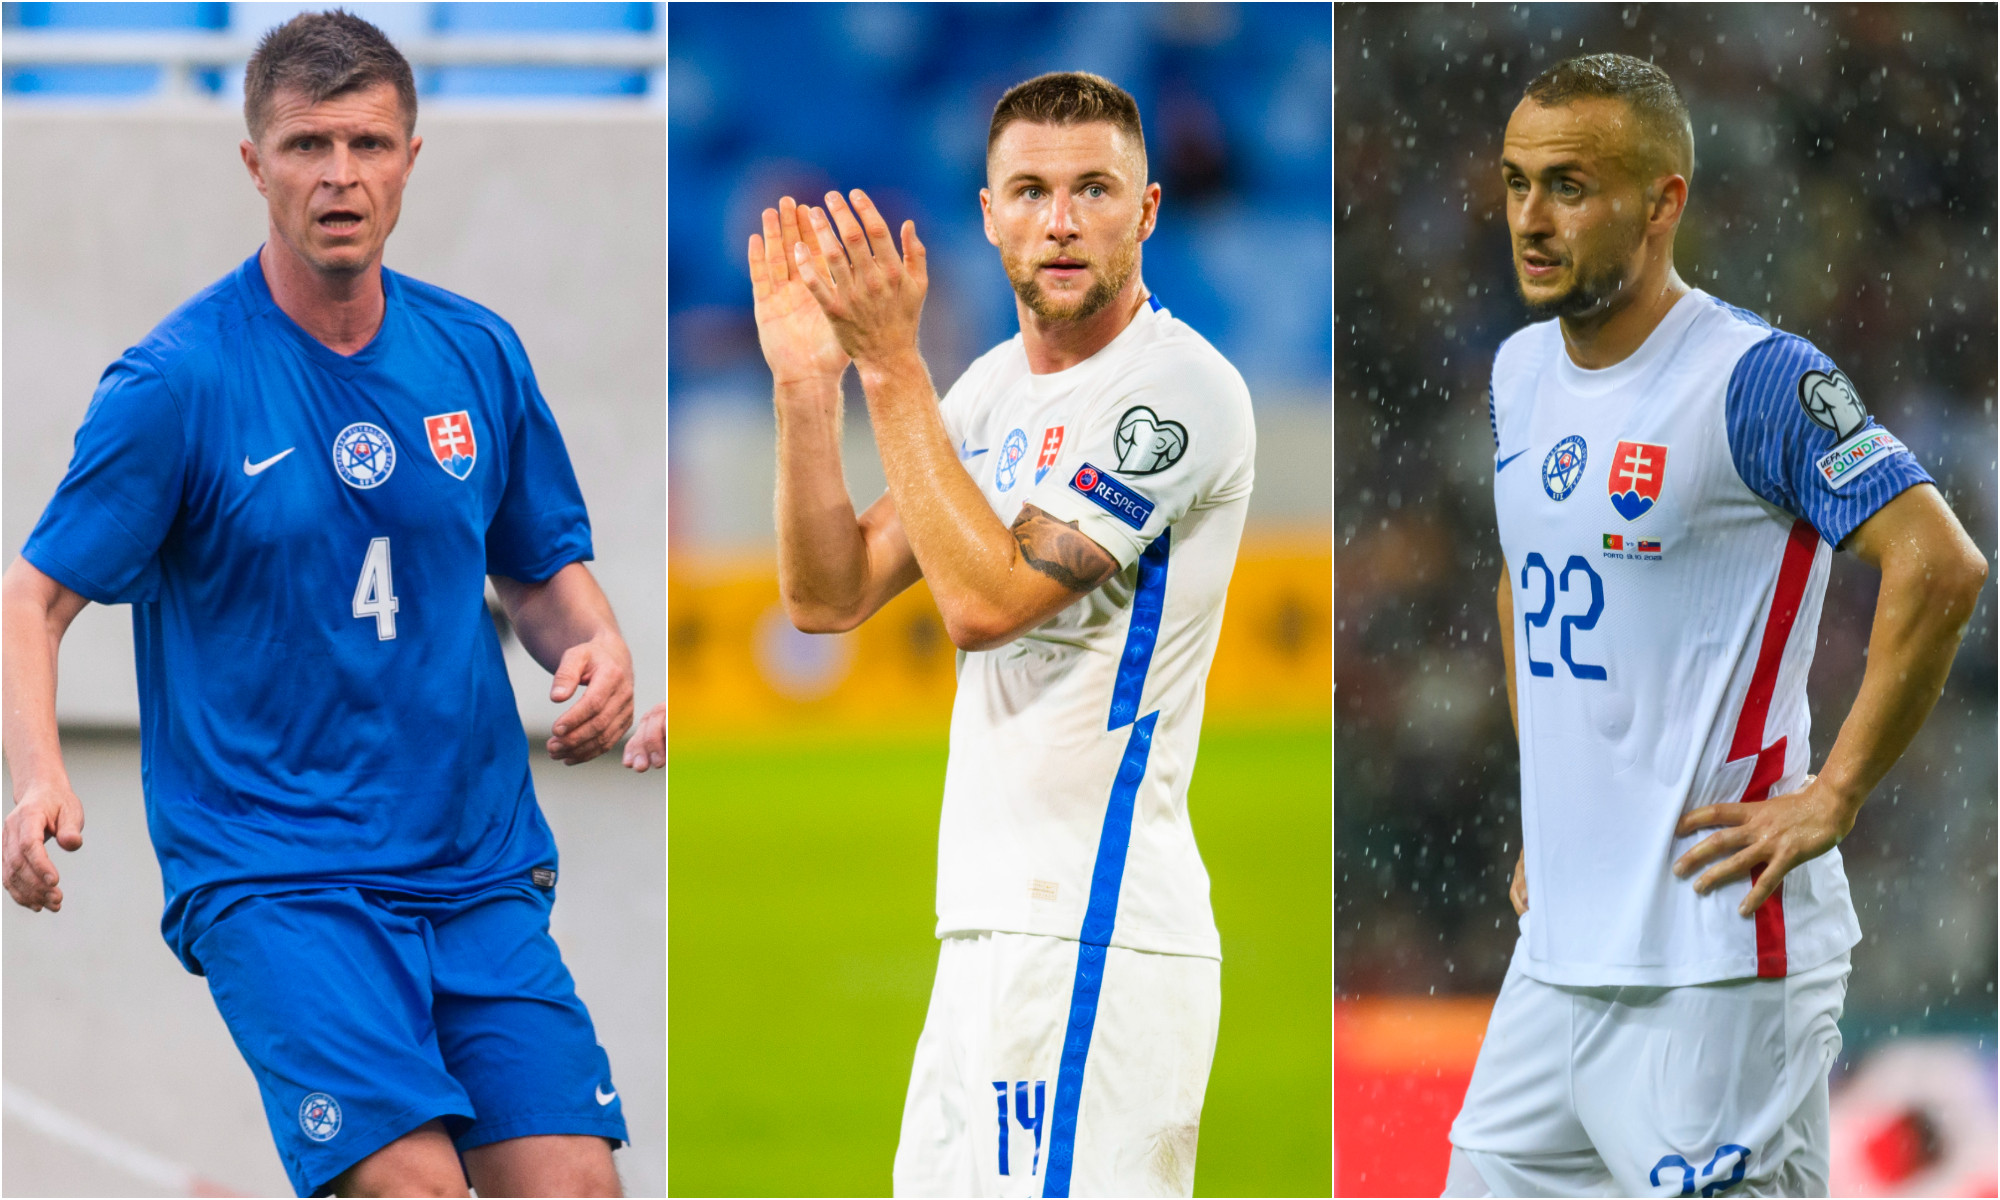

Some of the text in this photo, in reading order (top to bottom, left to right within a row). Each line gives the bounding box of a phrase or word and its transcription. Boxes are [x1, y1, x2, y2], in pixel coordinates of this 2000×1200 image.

[1820, 451, 1841, 469] UEFA
[1824, 434, 1897, 479] FOUNDATIO
[1095, 481, 1149, 522] RESPECT
[1603, 552, 1624, 560] PORTO
[352, 536, 399, 641] 4
[1521, 551, 1607, 681] 22
[991, 1080, 1046, 1176] 14
